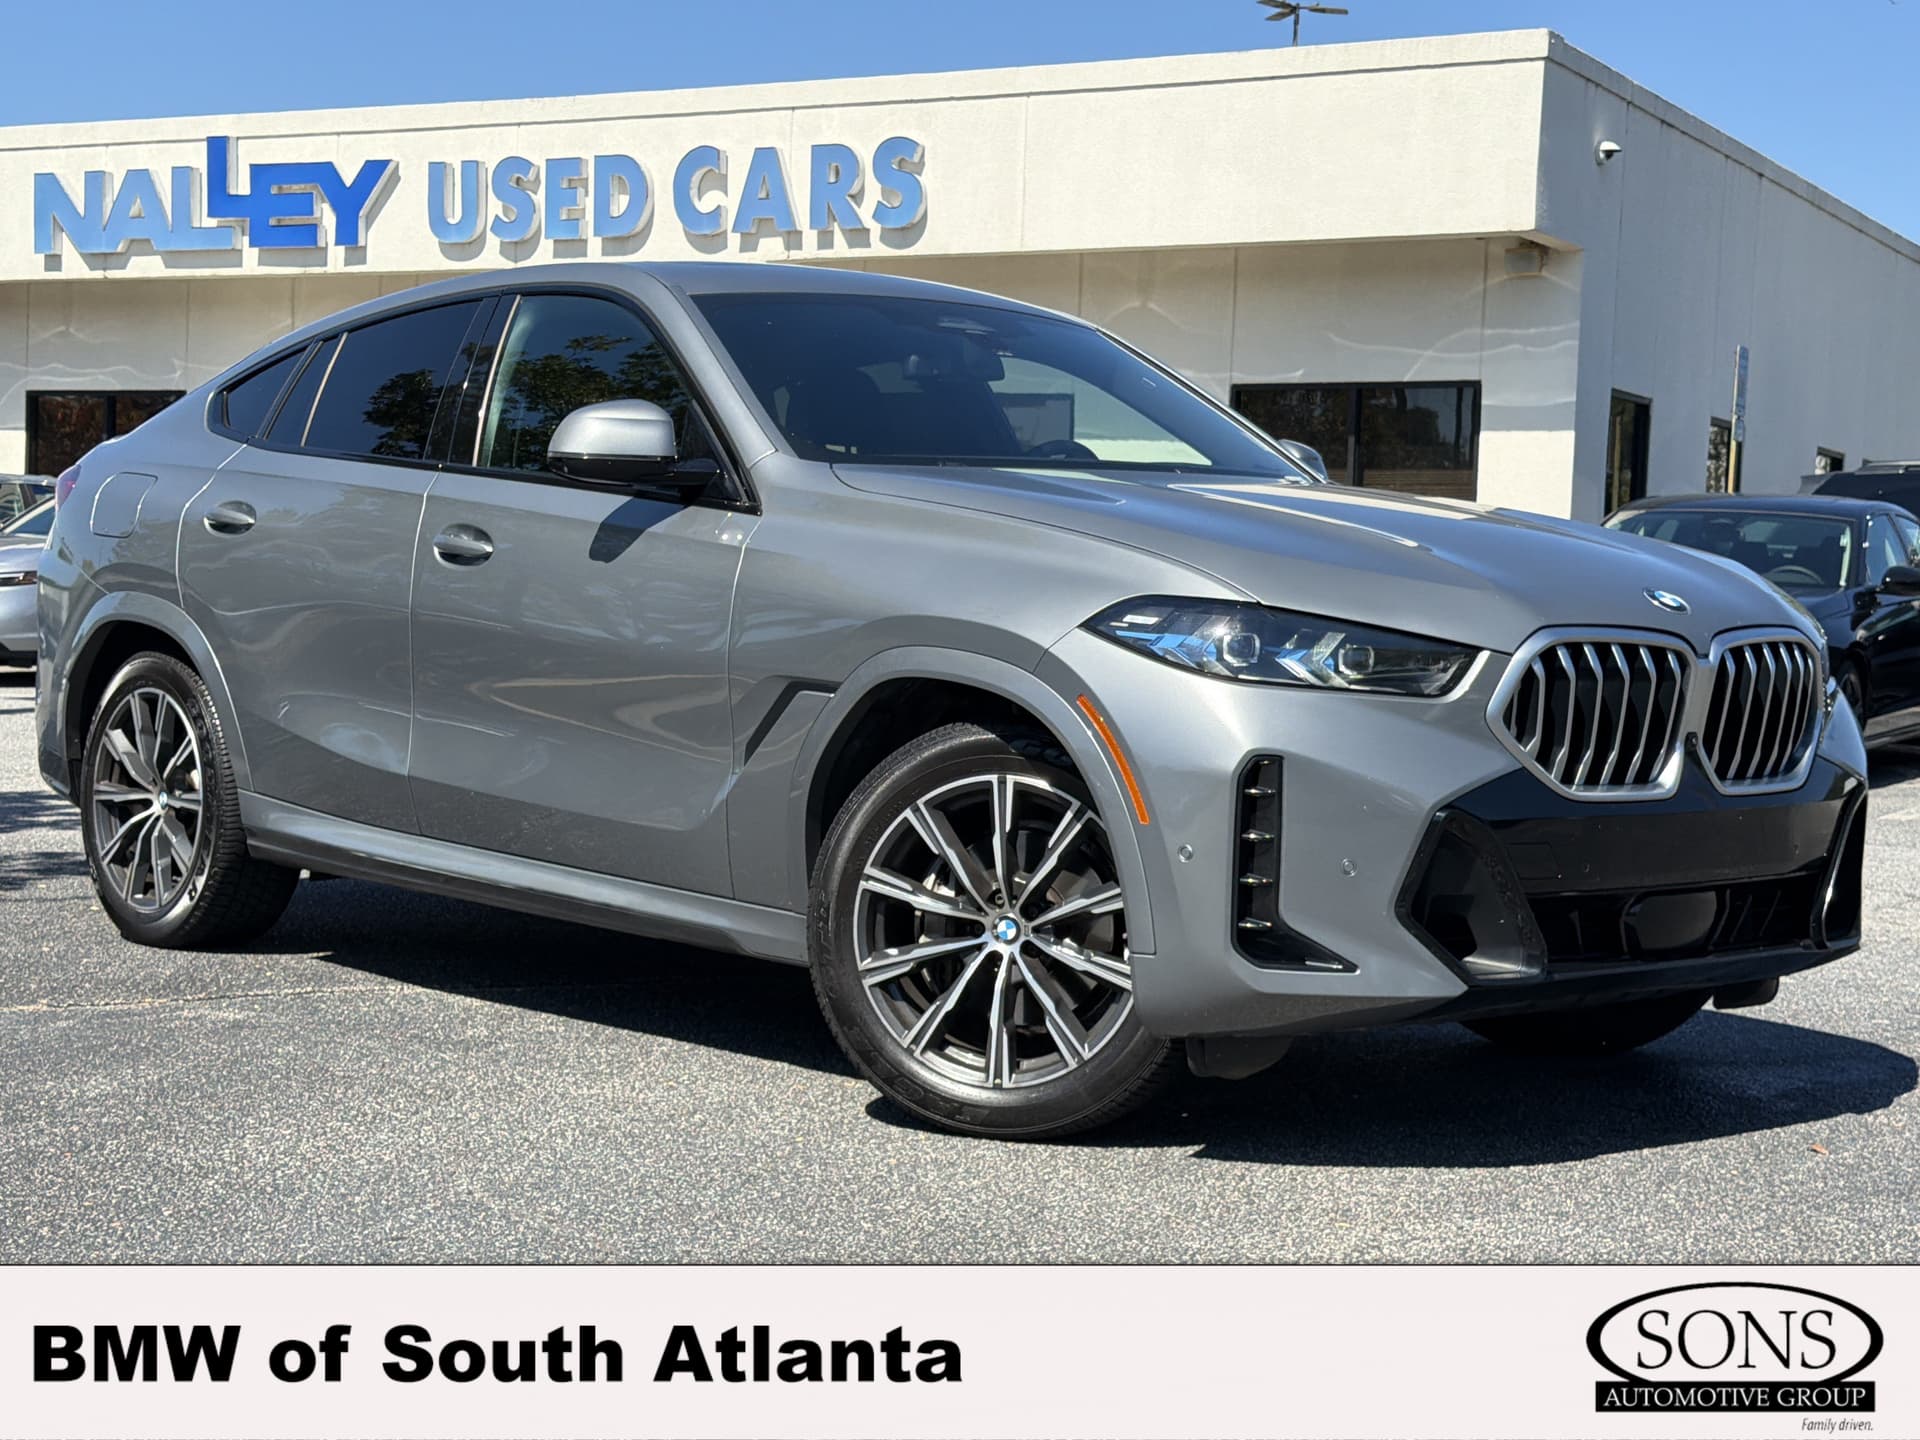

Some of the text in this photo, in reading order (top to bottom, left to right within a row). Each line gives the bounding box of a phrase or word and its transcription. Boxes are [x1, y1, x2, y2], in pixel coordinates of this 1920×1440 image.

[34, 136, 926, 255] NALLEY USED CARS
